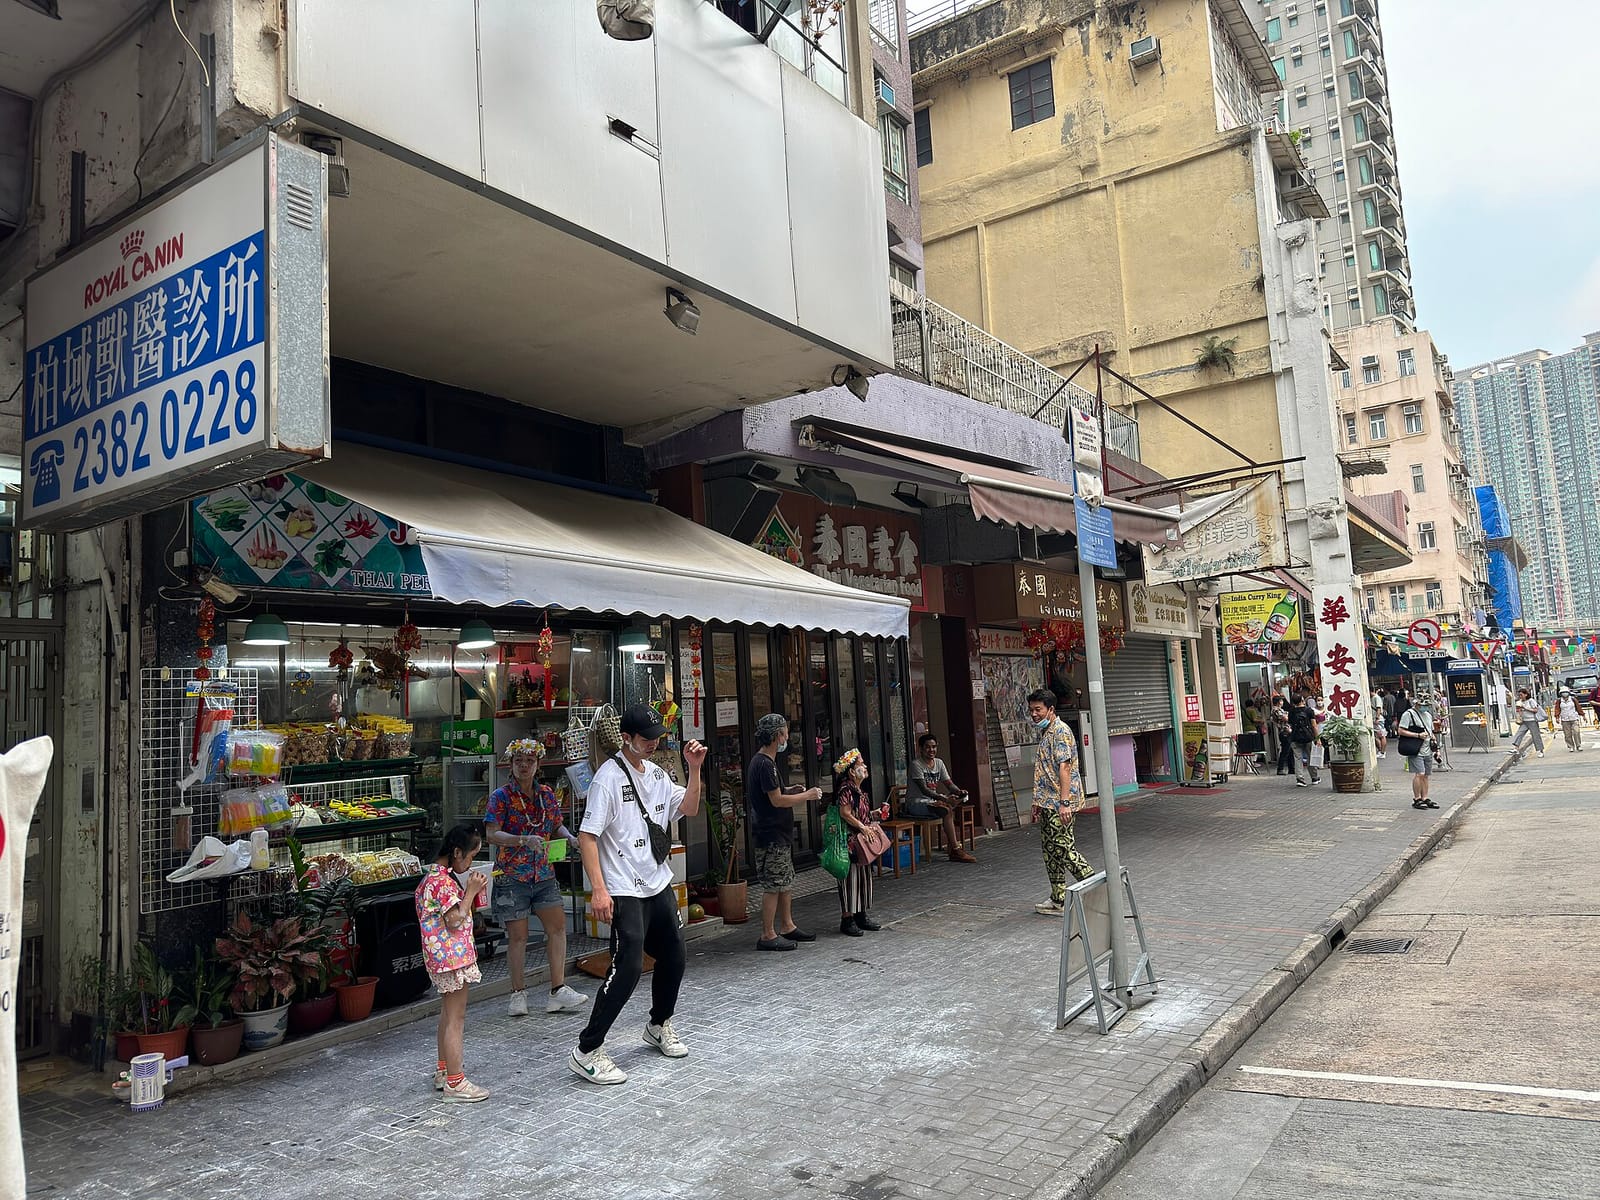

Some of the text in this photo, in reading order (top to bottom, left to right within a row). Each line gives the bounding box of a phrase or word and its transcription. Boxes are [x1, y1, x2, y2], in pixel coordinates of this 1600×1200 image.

[84, 232, 184, 309] ROYAL CANIN
[30, 241, 260, 434] 柏域獸醫診所
[73, 359, 257, 493] 2382 0228
[351, 570, 394, 589] THAI
[897, 576, 922, 597] Food
[1320, 595, 1361, 720] 華安押
[1454, 682, 1477, 691] Wi-Fi
